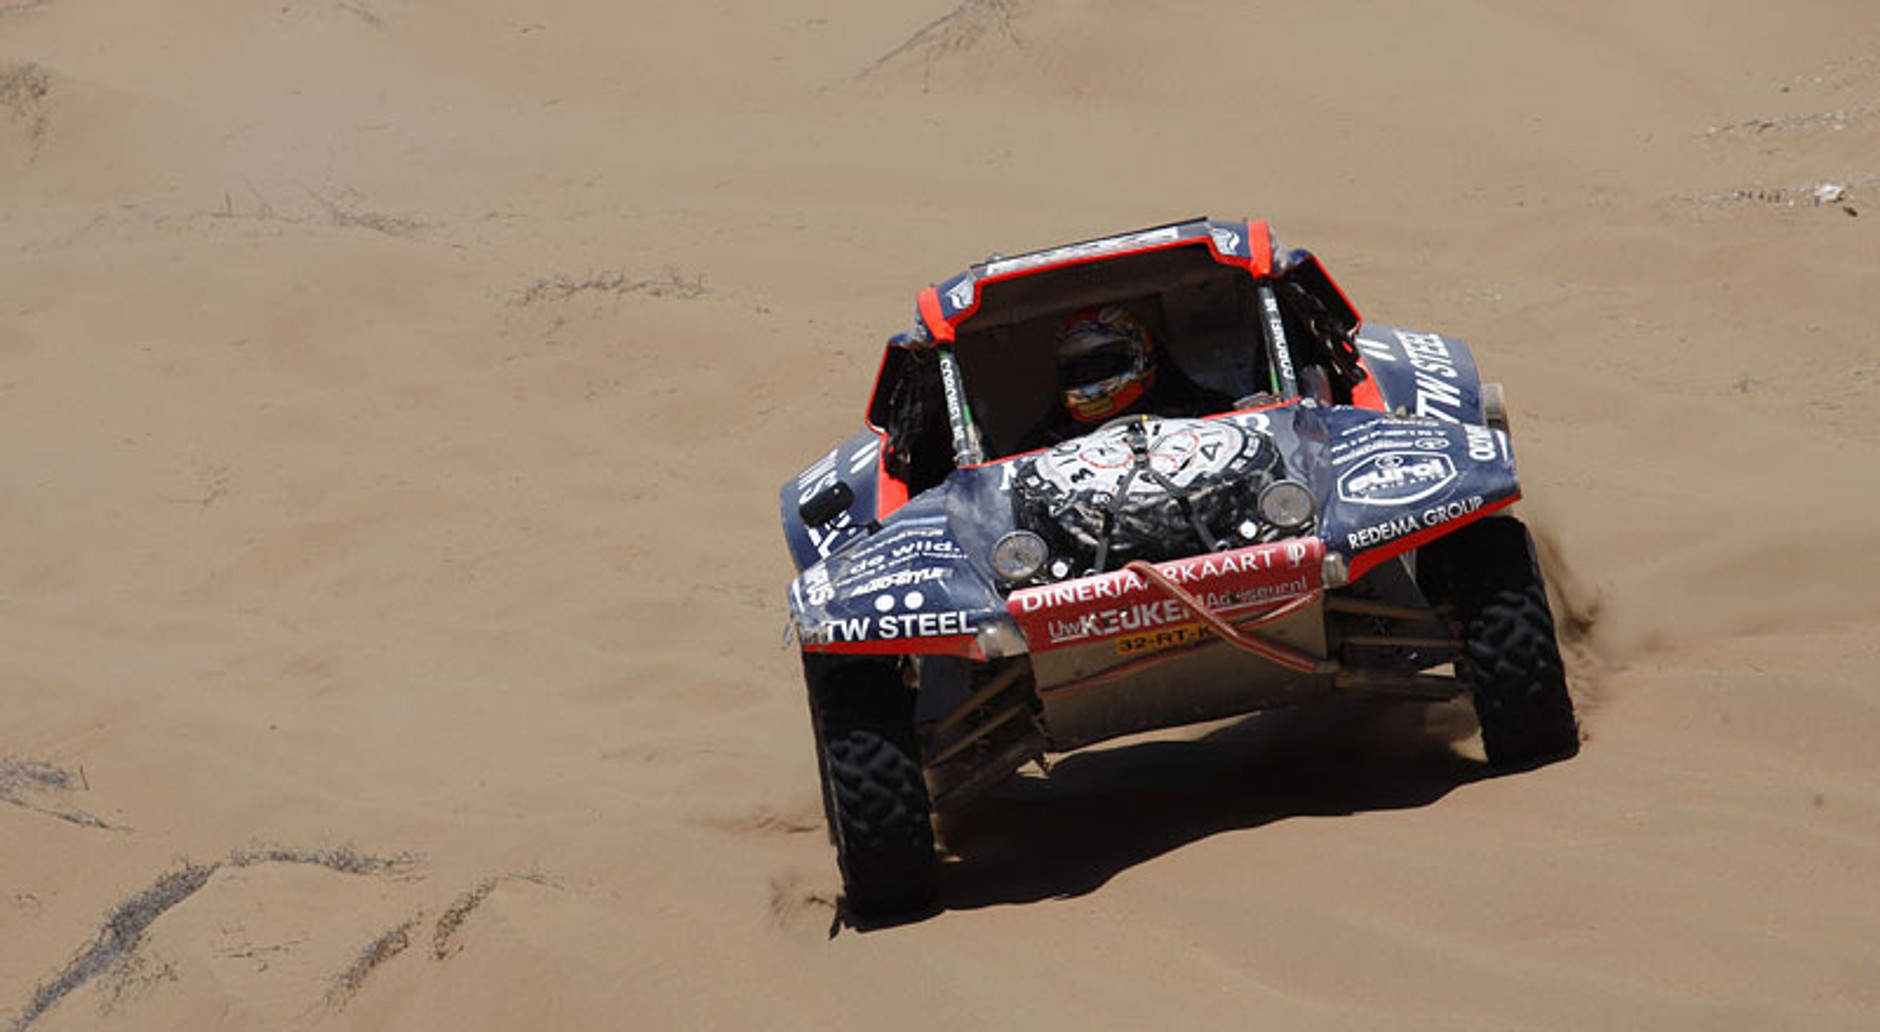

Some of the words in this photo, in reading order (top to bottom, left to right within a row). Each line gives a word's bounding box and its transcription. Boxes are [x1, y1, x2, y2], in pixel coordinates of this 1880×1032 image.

[1393, 329, 1459, 378] STEEL
[1415, 371, 1461, 425] TW
[1347, 514, 1421, 550] REDEMA
[1423, 496, 1485, 527] GROUP
[1020, 549, 1273, 613] DINERJARKAART
[821, 616, 871, 642] TW
[879, 610, 979, 639] STEEL
